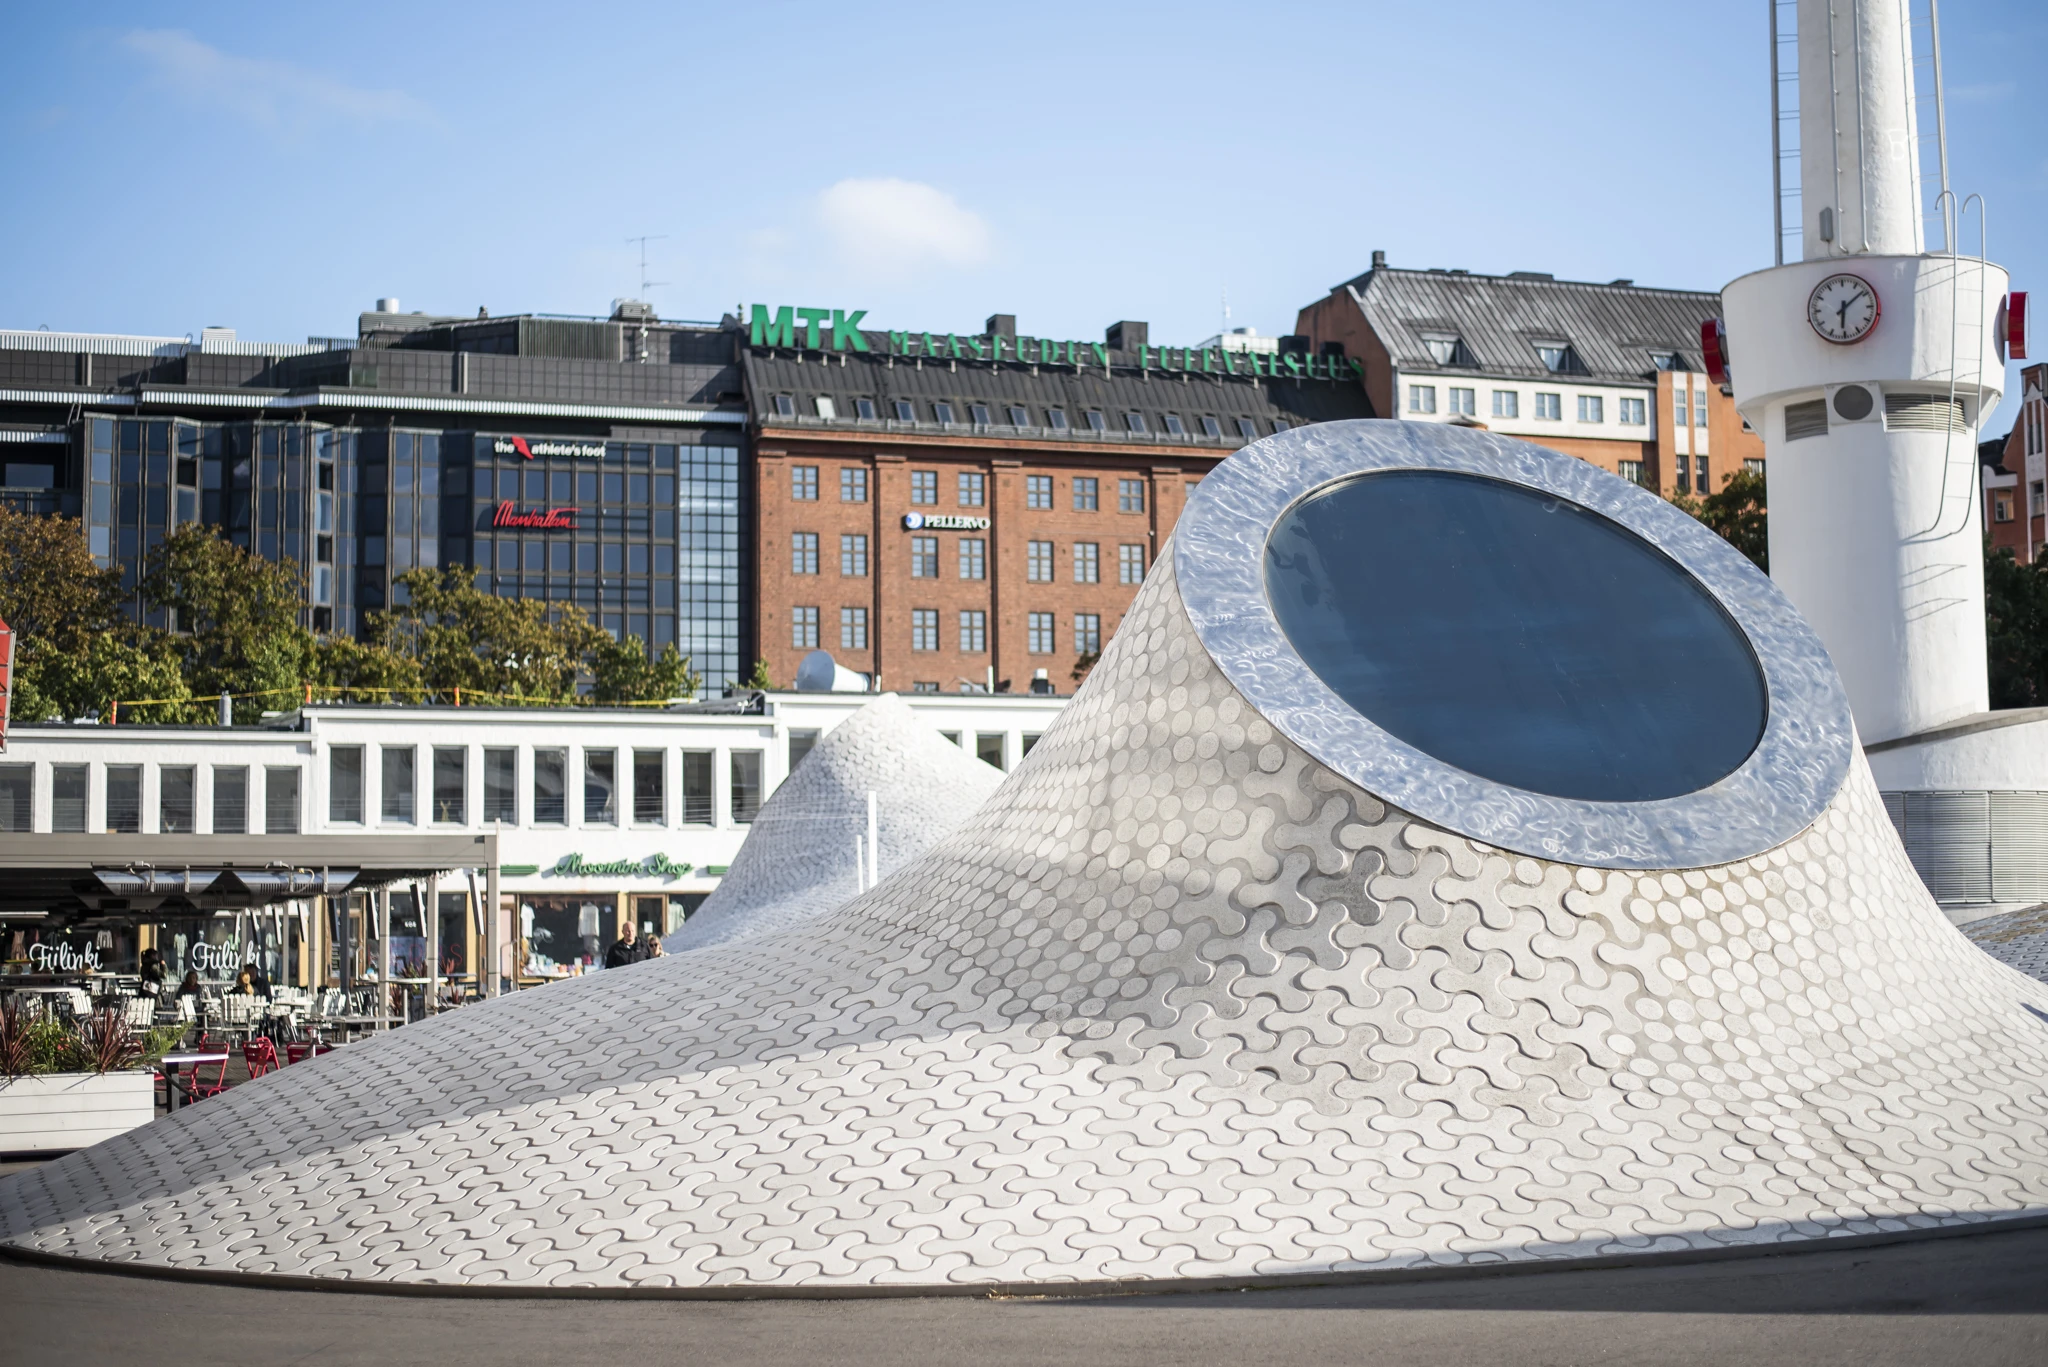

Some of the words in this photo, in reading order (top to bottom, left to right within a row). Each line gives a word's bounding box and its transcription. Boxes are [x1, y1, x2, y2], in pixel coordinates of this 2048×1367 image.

[750, 303, 869, 352] MTK
[494, 441, 515, 454] the
[531, 443, 581, 456] athlete's
[582, 445, 606, 457] foot
[493, 499, 582, 528] Manhattan
[924, 514, 991, 530] PELLERVO
[648, 852, 693, 880] Shop
[29, 941, 103, 972] Fiilinki
